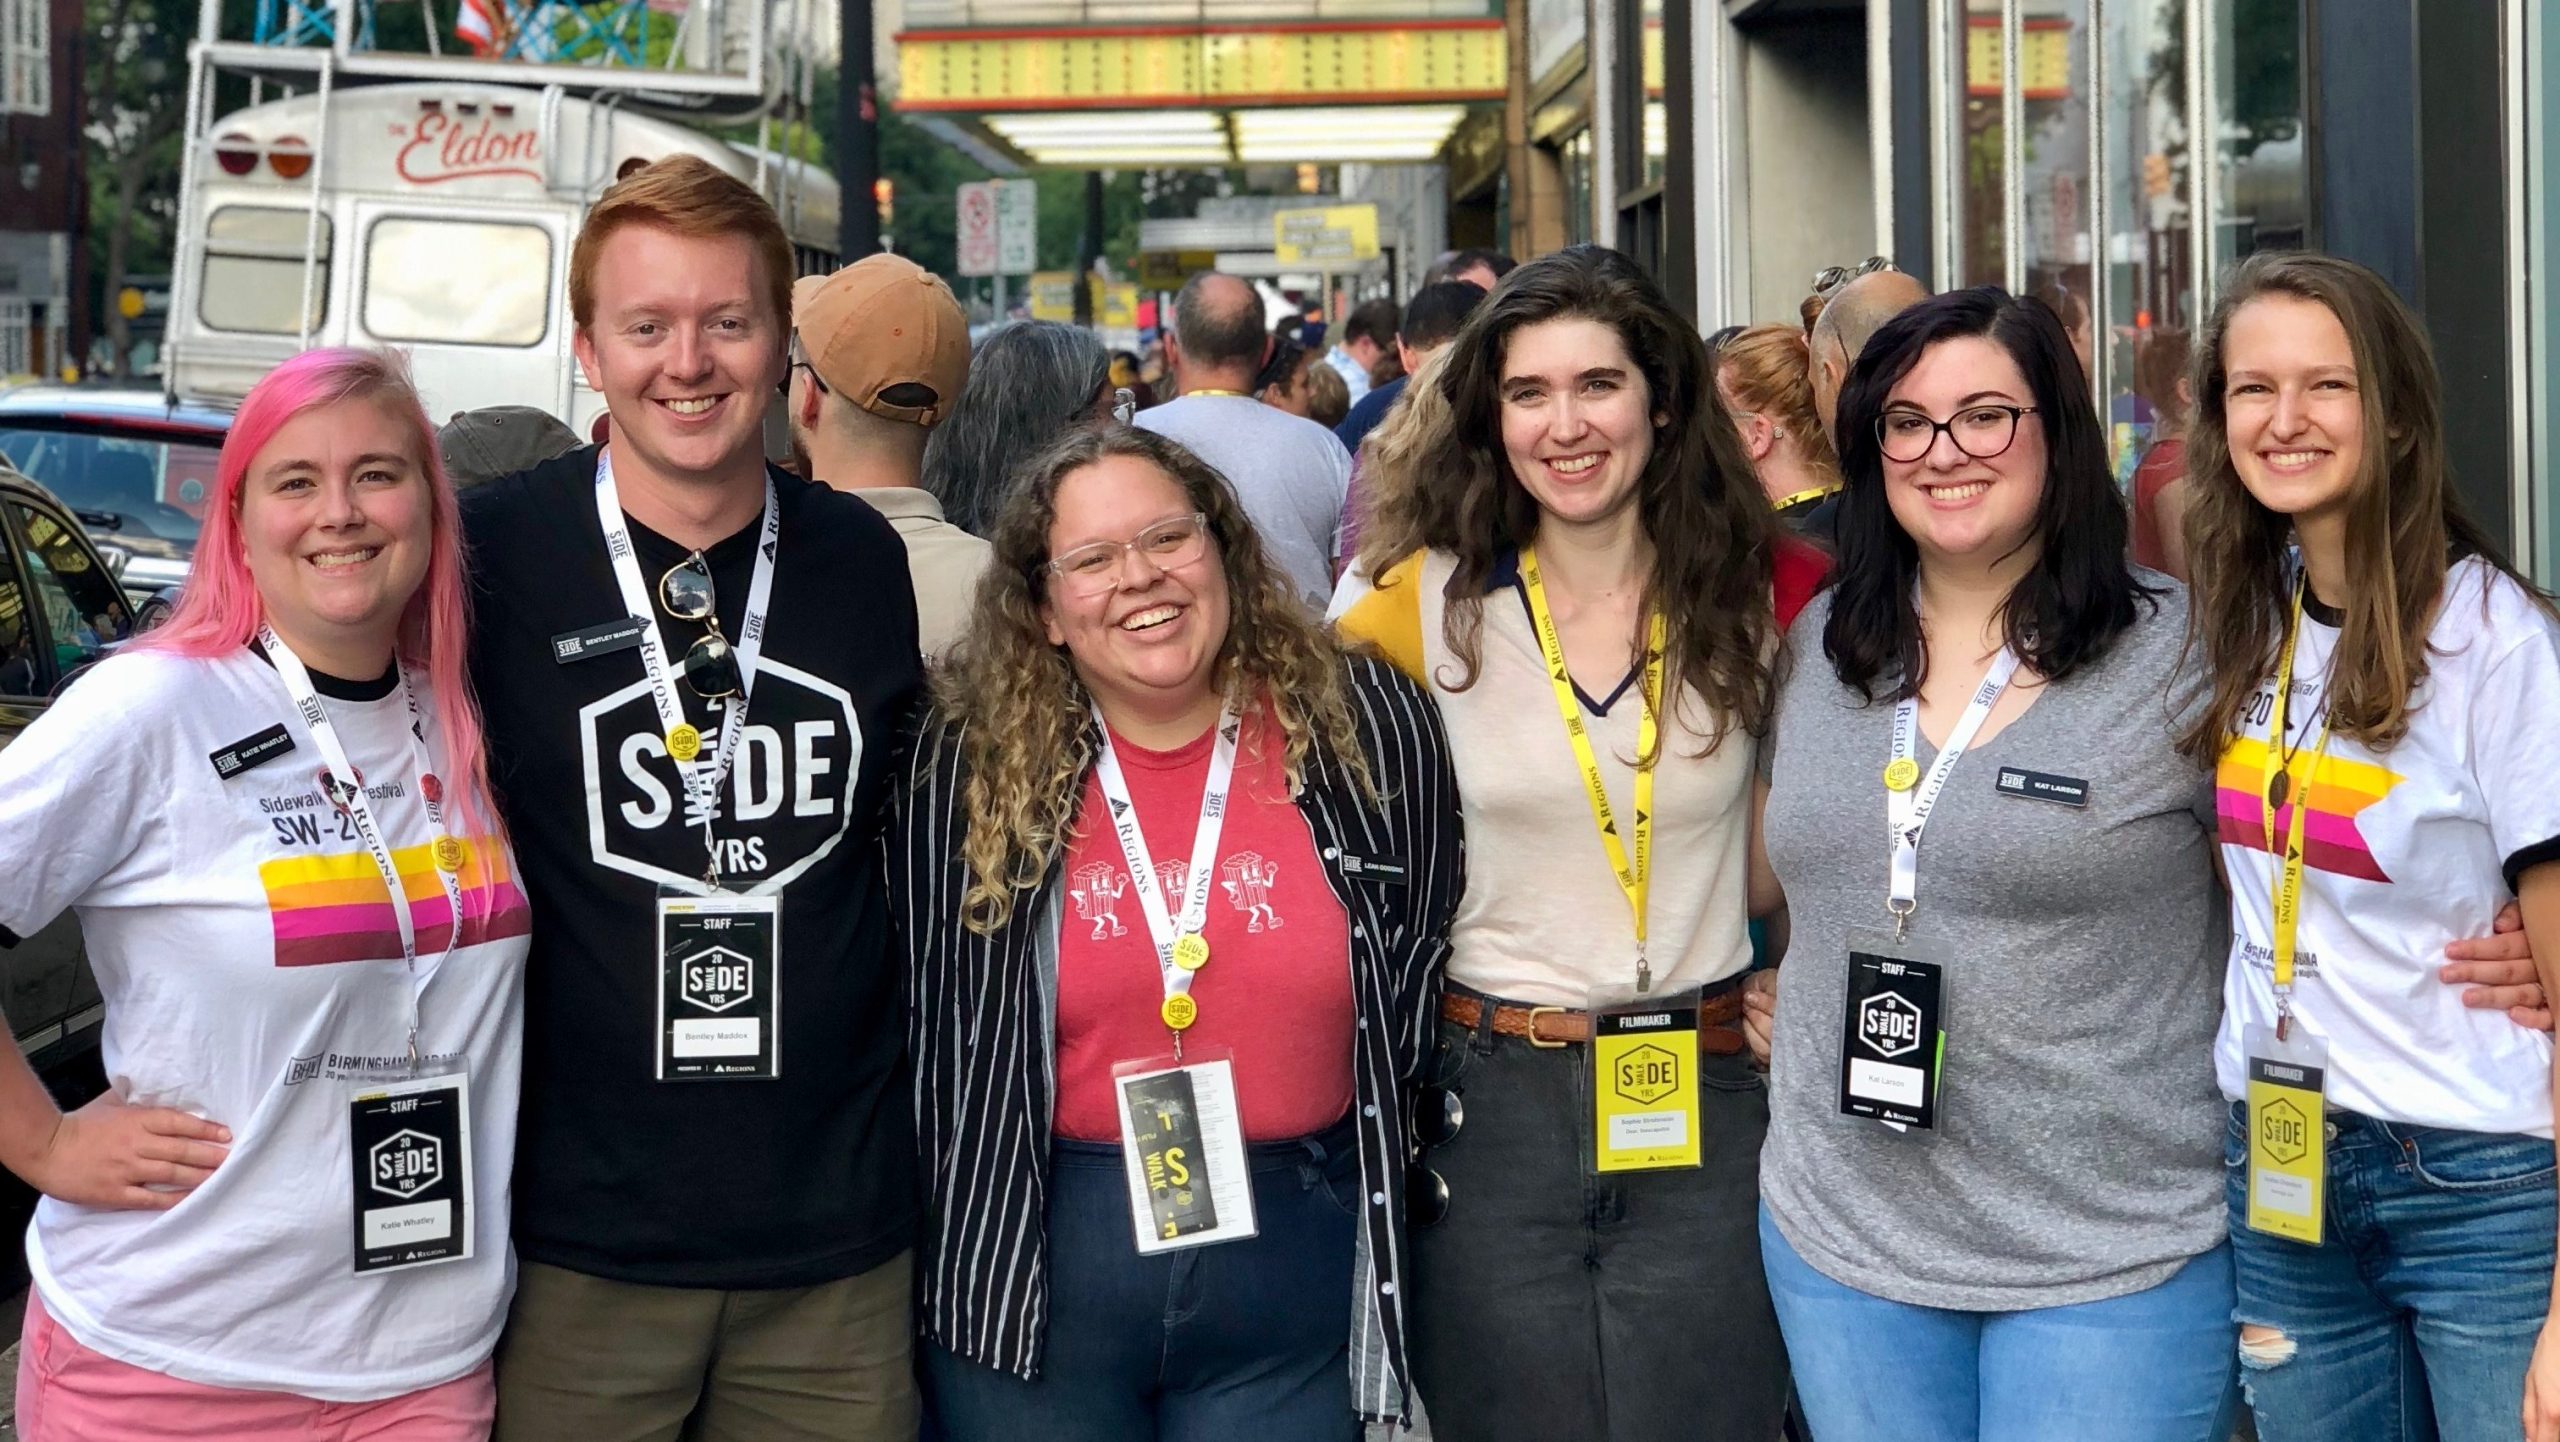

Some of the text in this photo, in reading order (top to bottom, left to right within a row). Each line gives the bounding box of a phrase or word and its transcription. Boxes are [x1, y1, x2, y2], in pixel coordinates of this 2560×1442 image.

[396, 112, 543, 184] Eldon
[1542, 614, 1562, 665] REGIONS
[641, 640, 674, 720] REGIONS
[241, 747, 260, 759] KATIE
[259, 733, 288, 751] WHATLEY
[1588, 766, 1611, 818] REGIONS
[1915, 750, 1960, 818] REGIONS
[2034, 782, 2050, 790] KAT
[259, 781, 406, 814] Sidewalk estival
[354, 807, 396, 886] REGIONS
[712, 836, 768, 876] YRS
[1118, 821, 1151, 894] REGIONS
[1636, 829, 1646, 882] REGIONS
[2280, 867, 2297, 925] REGIONS
[703, 918, 732, 930] STAFF
[712, 953, 723, 964] 20
[1881, 962, 1906, 976] STAFF
[709, 993, 726, 1004] YRS
[1619, 1014, 1671, 1029] FILMMAKER
[717, 1031, 748, 1040] Maddox
[2263, 1063, 2305, 1082] FILMMAKER
[1640, 1088, 1655, 1098] YRS
[390, 1099, 419, 1114] STAFF
[400, 1137, 411, 1148] 20
[1146, 1151, 1167, 1192] WALK
[399, 1178, 416, 1190] YRS
[402, 1215, 435, 1229] Whatley
